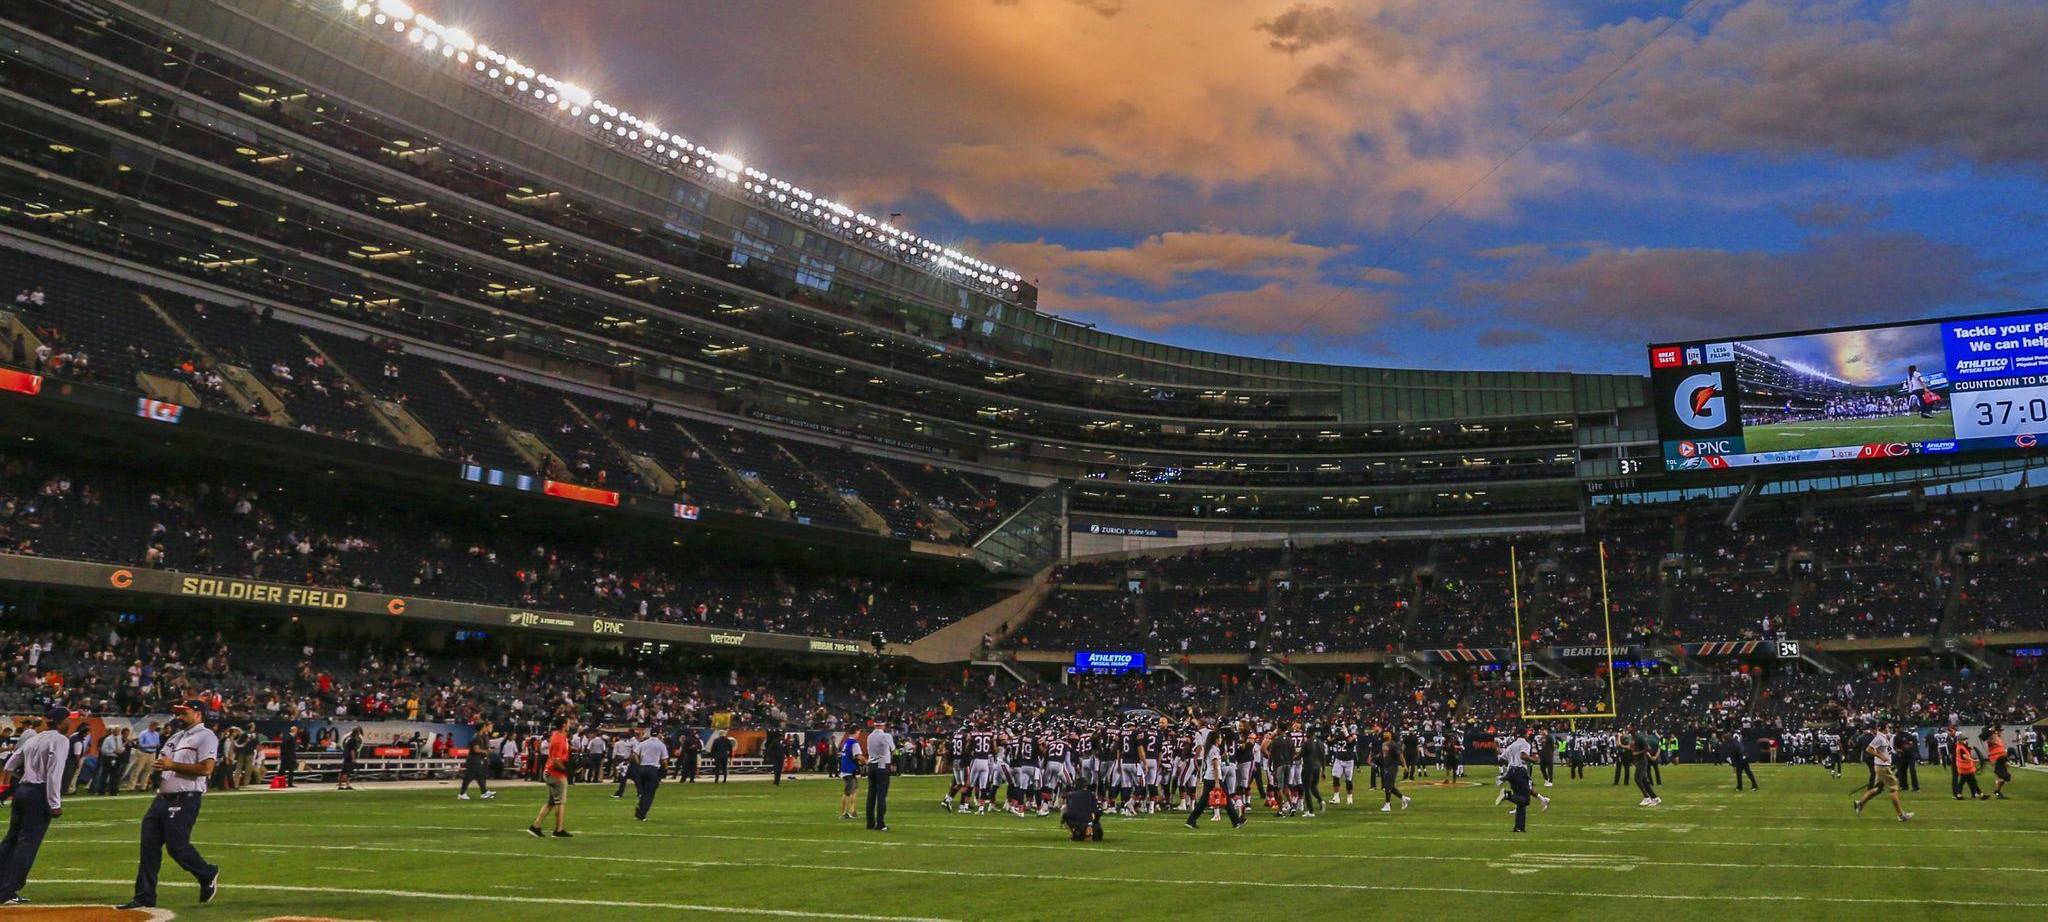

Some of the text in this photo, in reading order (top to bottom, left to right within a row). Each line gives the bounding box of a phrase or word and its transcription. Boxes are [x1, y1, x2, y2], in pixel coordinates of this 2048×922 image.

[1954, 325, 1996, 338] Tackle
[2000, 323, 2031, 336] your
[1970, 341, 1991, 352] We
[1995, 340, 2019, 350] can
[1956, 358, 2008, 370] ATHLETICO
[1955, 377, 2019, 390] COUNTDOWN
[2022, 376, 2036, 385] TO
[1696, 441, 1730, 455] PNC
[1832, 450, 1837, 458] 1
[1865, 447, 1872, 456] 0
[1713, 457, 1720, 466] 0
[1753, 456, 1760, 464] &
[1101, 527, 1125, 535] ZURICH
[182, 577, 347, 609] SOLDIER FIELD
[521, 611, 540, 626] Lite
[603, 622, 624, 634] PNC
[710, 632, 742, 645] verizon
[1563, 647, 1628, 657] BEAR DOWN
[1781, 643, 1797, 656] 34
[1088, 653, 1132, 662] ATHLETICO
[974, 735, 990, 752] 36
[1048, 743, 1065, 756] 29
[1123, 735, 1130, 753] 6
[1146, 735, 1155, 752] 2
[1162, 744, 1173, 761] 25
